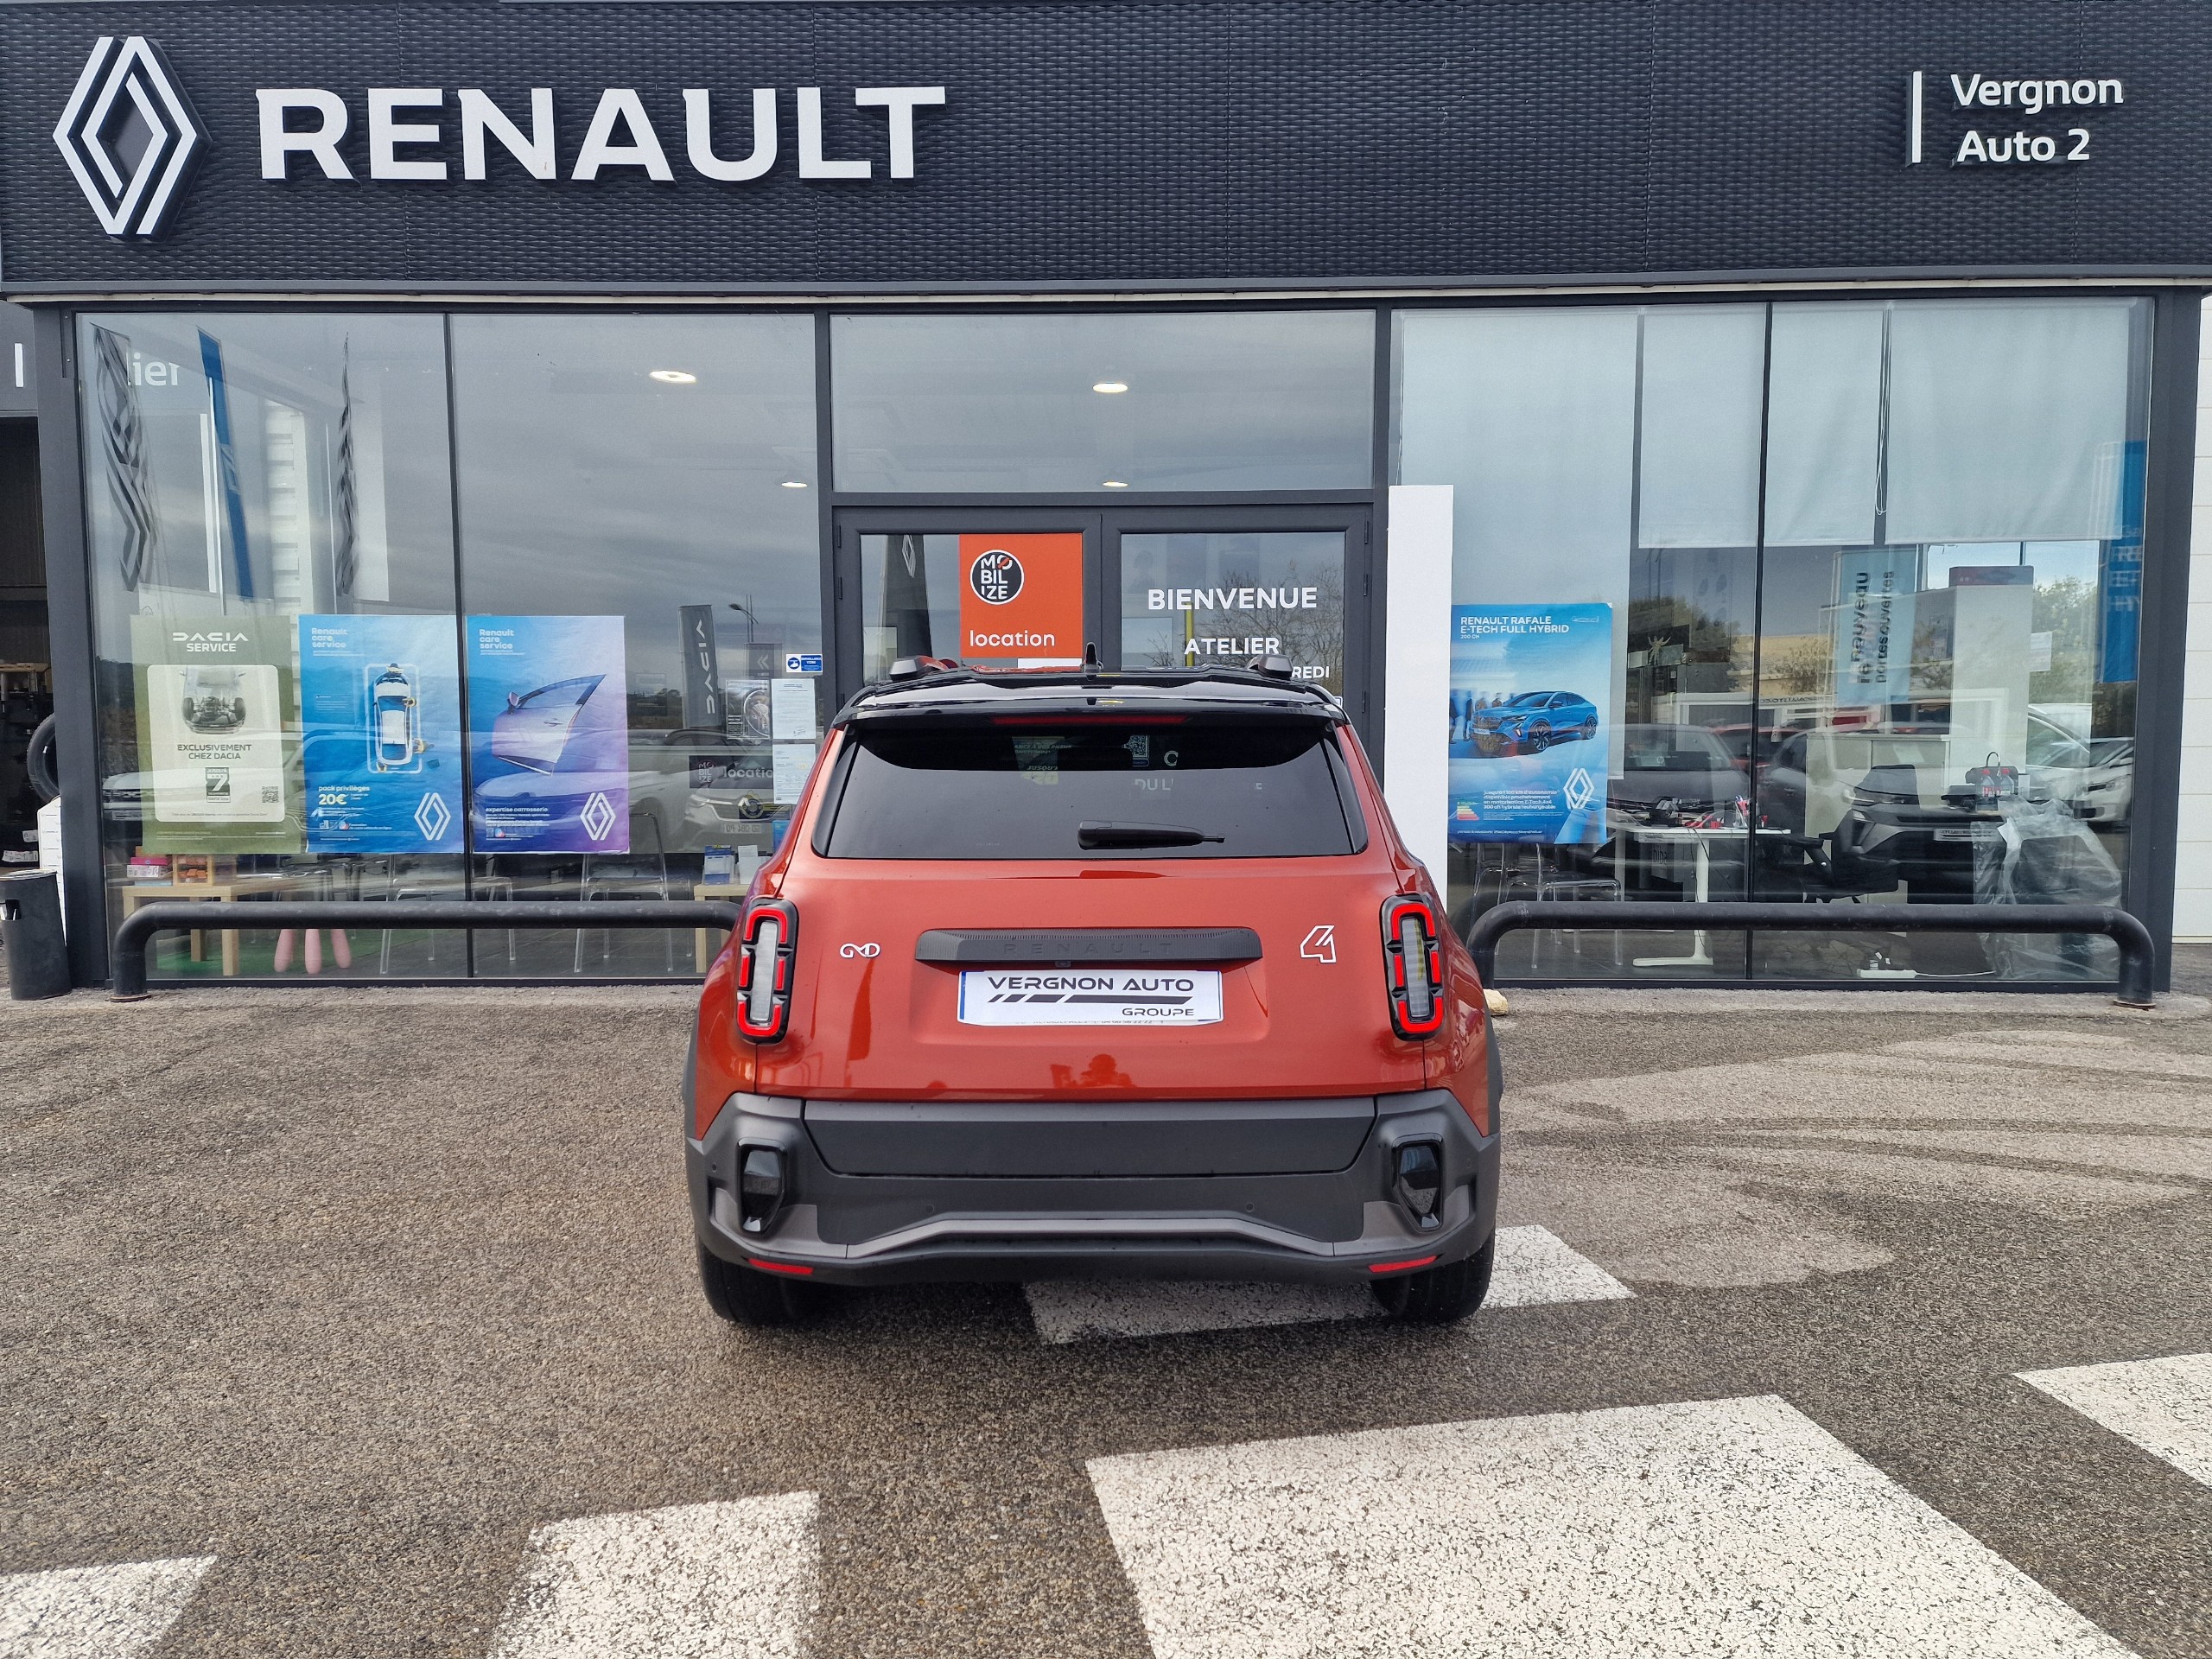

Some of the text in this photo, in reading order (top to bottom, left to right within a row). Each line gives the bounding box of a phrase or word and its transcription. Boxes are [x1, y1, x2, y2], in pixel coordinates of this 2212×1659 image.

[1950, 73, 2125, 115] Vergnon
[256, 86, 946, 181] RENAULT
[1956, 129, 2091, 162] Auto 2
[126, 352, 181, 386] ier
[1147, 587, 1318, 610] BIENVENUE
[1460, 616, 1552, 625] RENAULT RAFALE
[479, 628, 515, 637] Renault
[1460, 624, 1569, 633] E-TECH FULL HYBRID
[172, 632, 250, 642] DACIA
[969, 629, 1056, 647] location
[186, 643, 237, 652] SERVICE
[1184, 637, 1281, 656] ATELIER
[1291, 665, 1330, 679] REDI
[723, 766, 773, 779] locatio
[318, 793, 347, 805] 20€
[1003, 943, 1173, 955] RENAULT
[988, 976, 1194, 992] VERGNON AUTO
[1122, 1007, 1195, 1017] GROUPE
